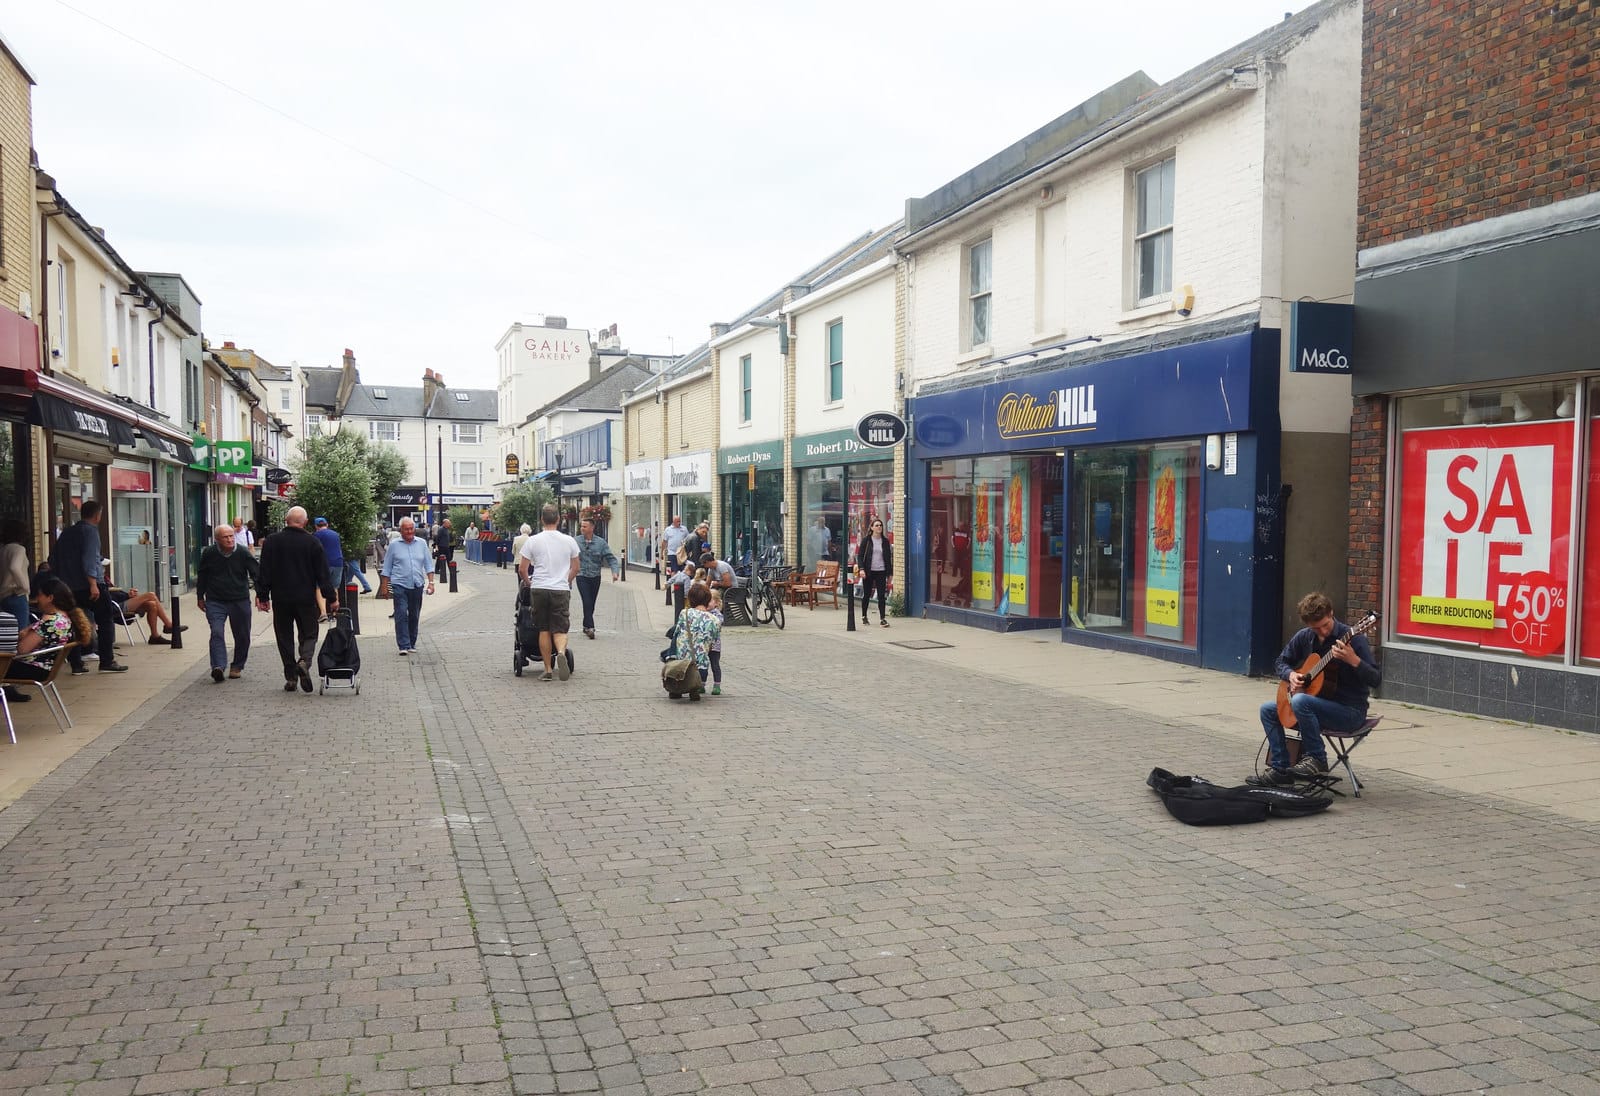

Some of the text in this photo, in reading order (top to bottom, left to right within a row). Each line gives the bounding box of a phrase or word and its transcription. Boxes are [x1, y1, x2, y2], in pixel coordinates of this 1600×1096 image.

[532, 352, 572, 360] BAKERY
[1301, 347, 1349, 369] M&Co.
[1058, 384, 1097, 427] HILL
[868, 429, 896, 442] HILL
[806, 438, 870, 455] Robert Dya
[727, 451, 771, 465] Robert Dyas
[1412, 603, 1492, 620] FURTHER REDUCTIONS
